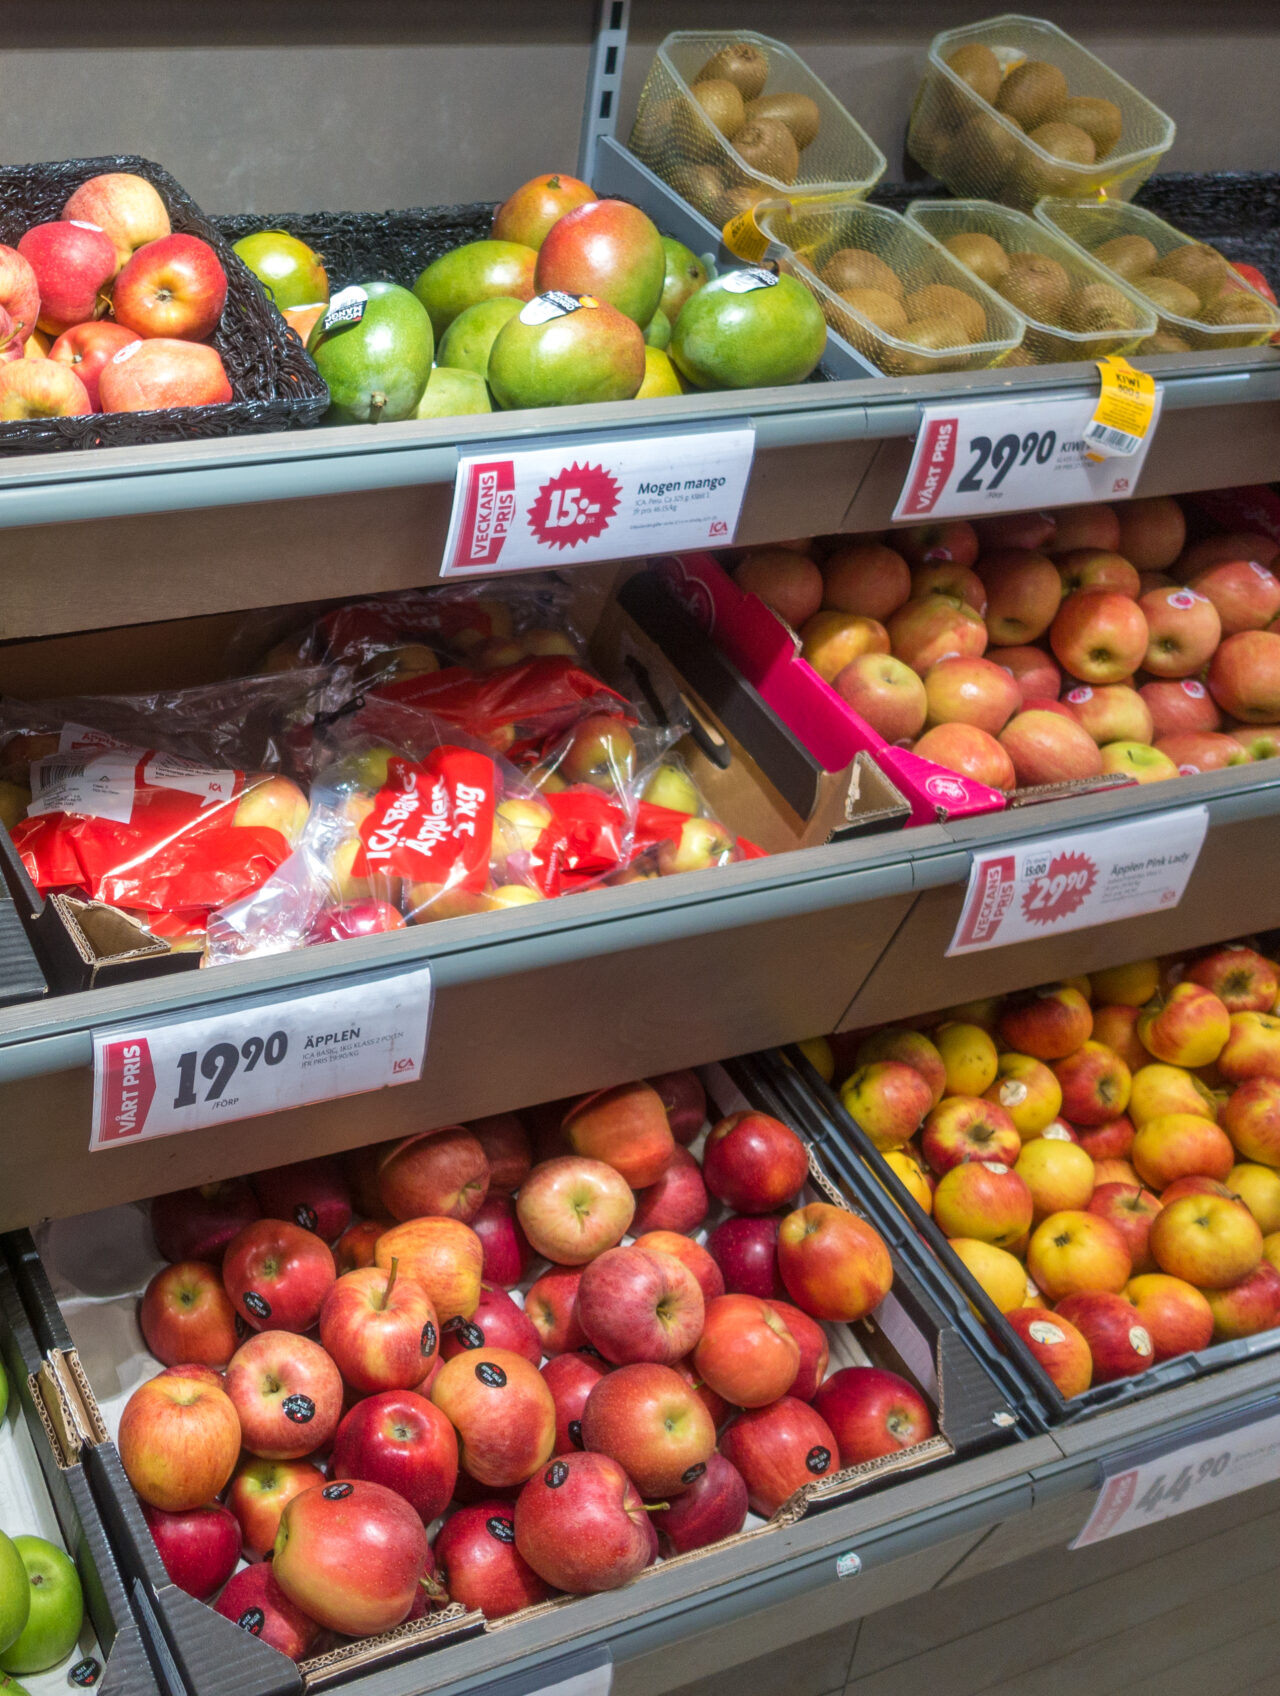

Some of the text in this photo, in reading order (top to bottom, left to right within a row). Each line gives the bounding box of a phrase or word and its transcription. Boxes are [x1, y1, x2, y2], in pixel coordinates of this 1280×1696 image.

[932, 423, 953, 463] PRIS
[638, 476, 727, 497] Mogen mango
[916, 466, 942, 510] VÅRT
[473, 474, 496, 557] VECKANS
[493, 493, 514, 535] PRIS
[709, 521, 728, 534] ICA
[366, 822, 405, 860] ICA
[1110, 852, 1191, 878] Äpplen Pink Lady
[975, 868, 1002, 938] VECKANS
[993, 883, 1014, 918] PRIS
[303, 1027, 361, 1050] ÄPPLEN
[354, 1039, 374, 1049] KLASS
[123, 1044, 142, 1086] PRIS
[313, 1056, 328, 1065] PRIS
[392, 1057, 415, 1072] ICA
[116, 1093, 139, 1135] VÅRT
[212, 1096, 240, 1111] /FÖRP
